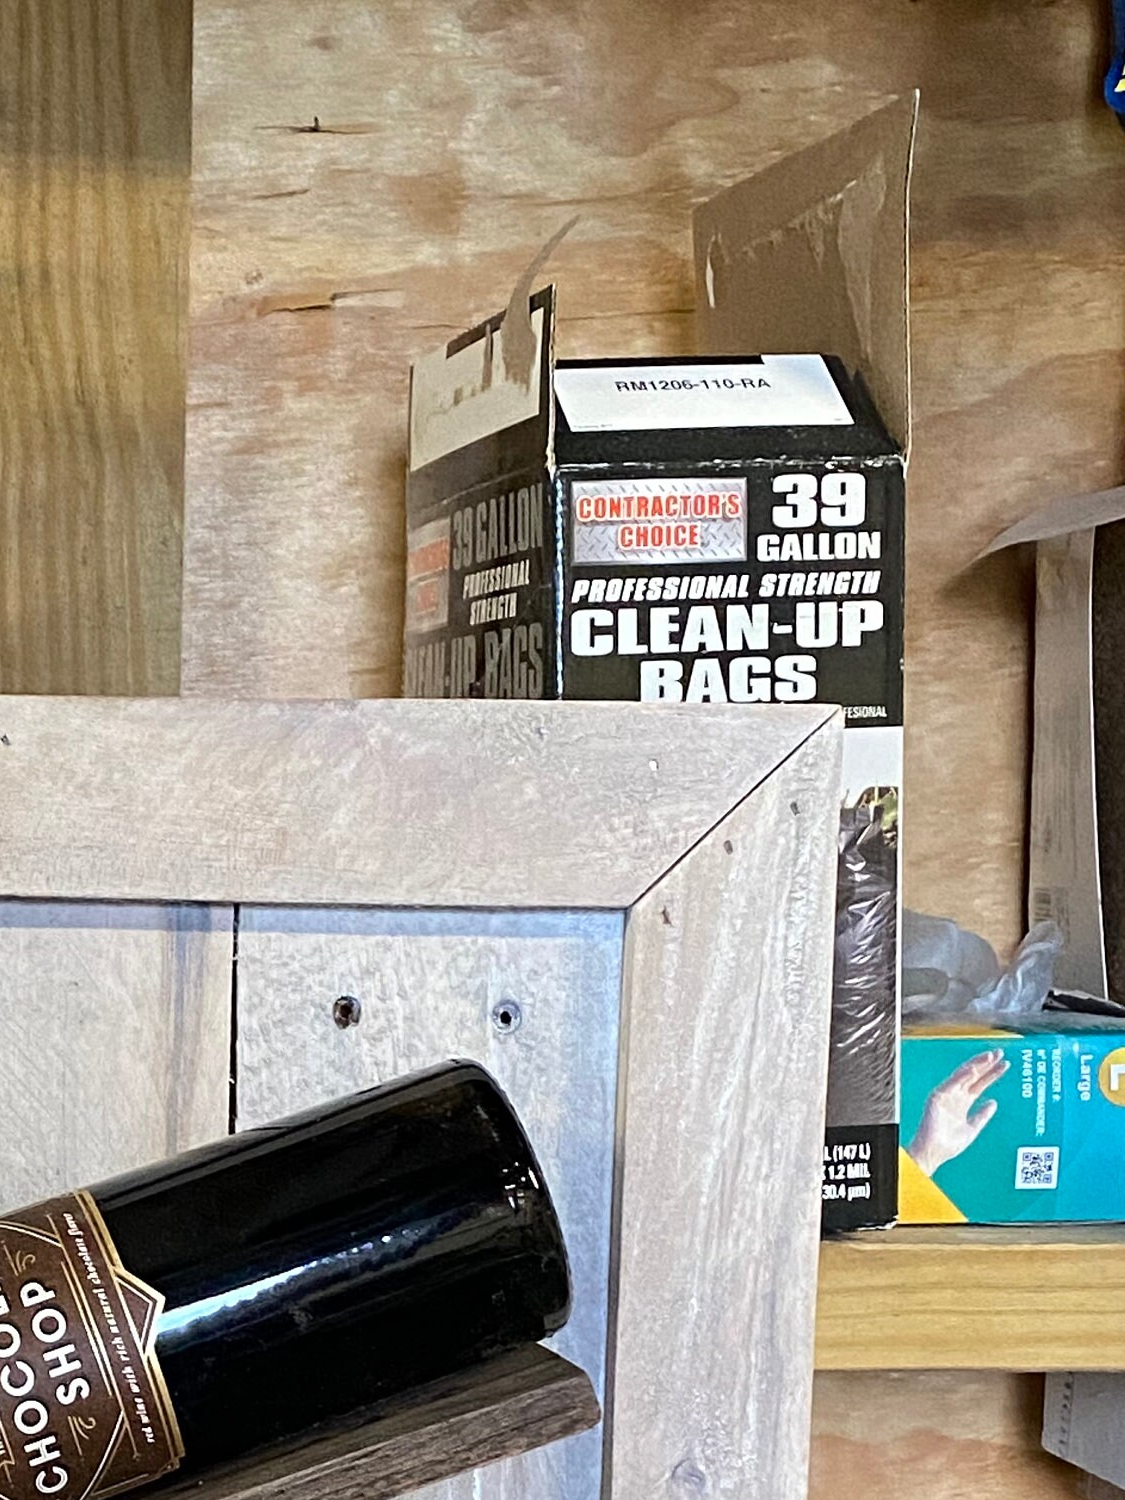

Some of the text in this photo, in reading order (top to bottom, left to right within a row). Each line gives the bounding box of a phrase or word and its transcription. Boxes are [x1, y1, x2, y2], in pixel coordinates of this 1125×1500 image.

[614, 377, 772, 393] RM1206-110-RA
[577, 493, 741, 520] CONTRACTOR'S
[771, 471, 867, 529] 39
[452, 506, 474, 572] 39
[475, 482, 544, 564] GALLON
[619, 523, 700, 549] CHOICE
[756, 531, 882, 563] GALLON
[463, 558, 531, 600] PROFESSIONAL
[571, 570, 882, 604] PROFESSIONAL STRENGTH
[469, 591, 518, 627] STRENGTH
[570, 600, 885, 657] CLEAN-UP
[483, 621, 544, 699] BAGS
[640, 653, 818, 703] BAGS
[1077, 1053, 1094, 1101] Large
[75, 1237, 102, 1285] chocolate
[92, 1288, 120, 1334] natural
[19, 1281, 91, 1406] SHOP
[111, 1336, 130, 1361] rich
[121, 1365, 141, 1393] with
[134, 1397, 150, 1424] wine
[141, 1426, 155, 1443] red
